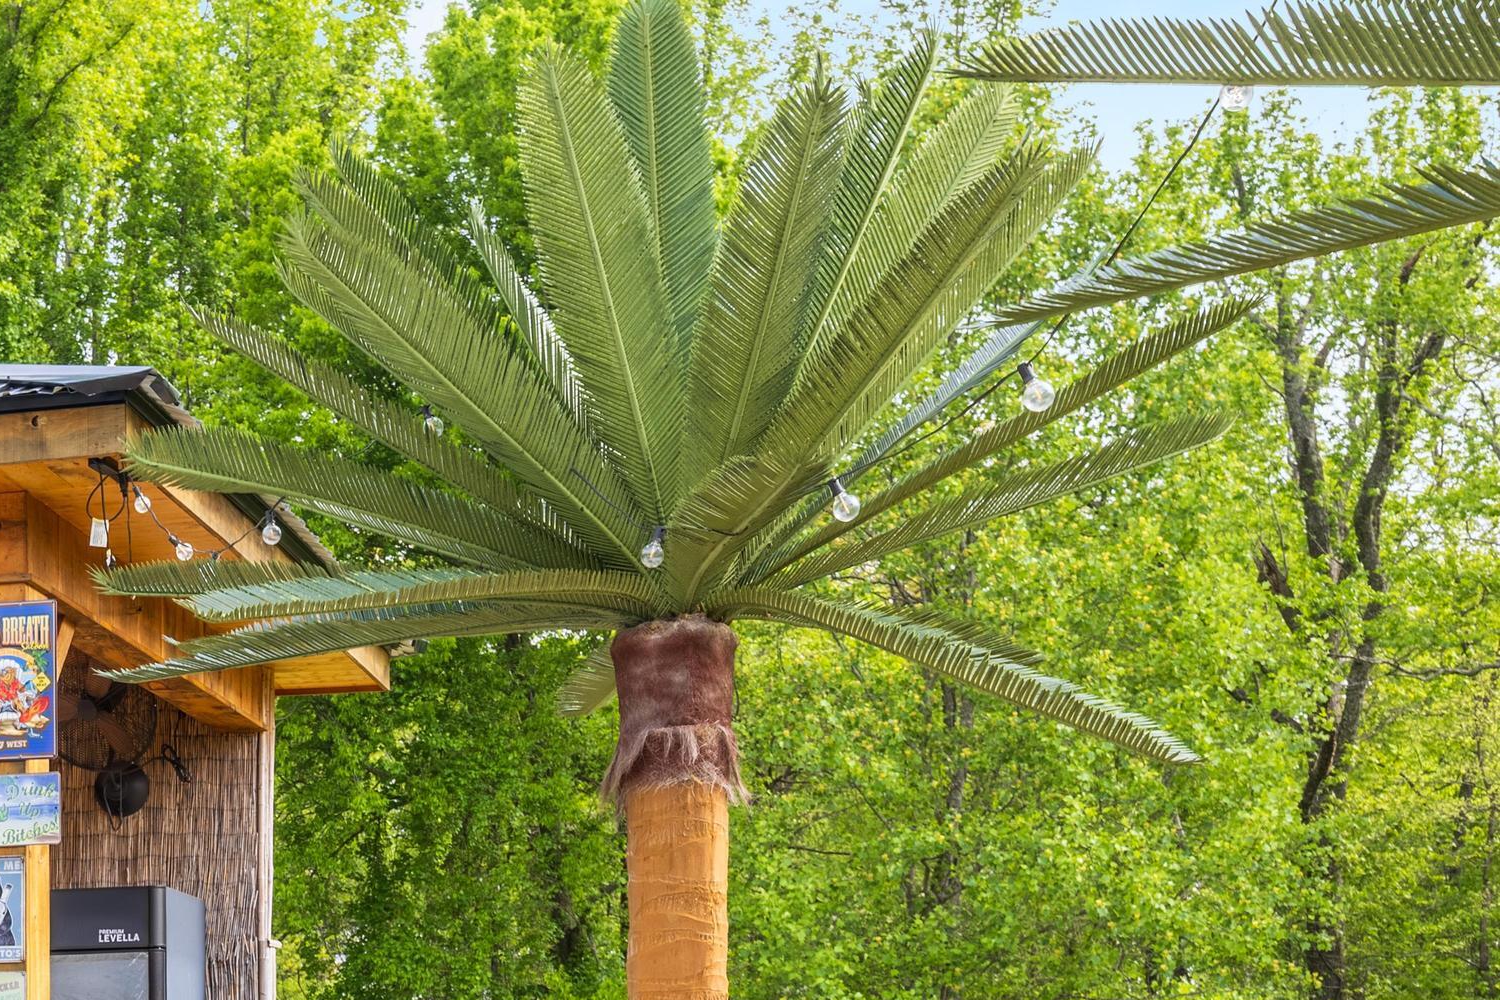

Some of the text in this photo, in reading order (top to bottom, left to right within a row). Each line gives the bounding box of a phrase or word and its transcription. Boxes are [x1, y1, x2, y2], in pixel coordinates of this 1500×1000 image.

[2, 614, 50, 649] BREATH
[6, 740, 27, 748] WEST
[5, 782, 56, 801] Drink
[2, 813, 59, 844] Bitches!
[4, 861, 21, 871] ME
[98, 933, 140, 942] LEVELLA
